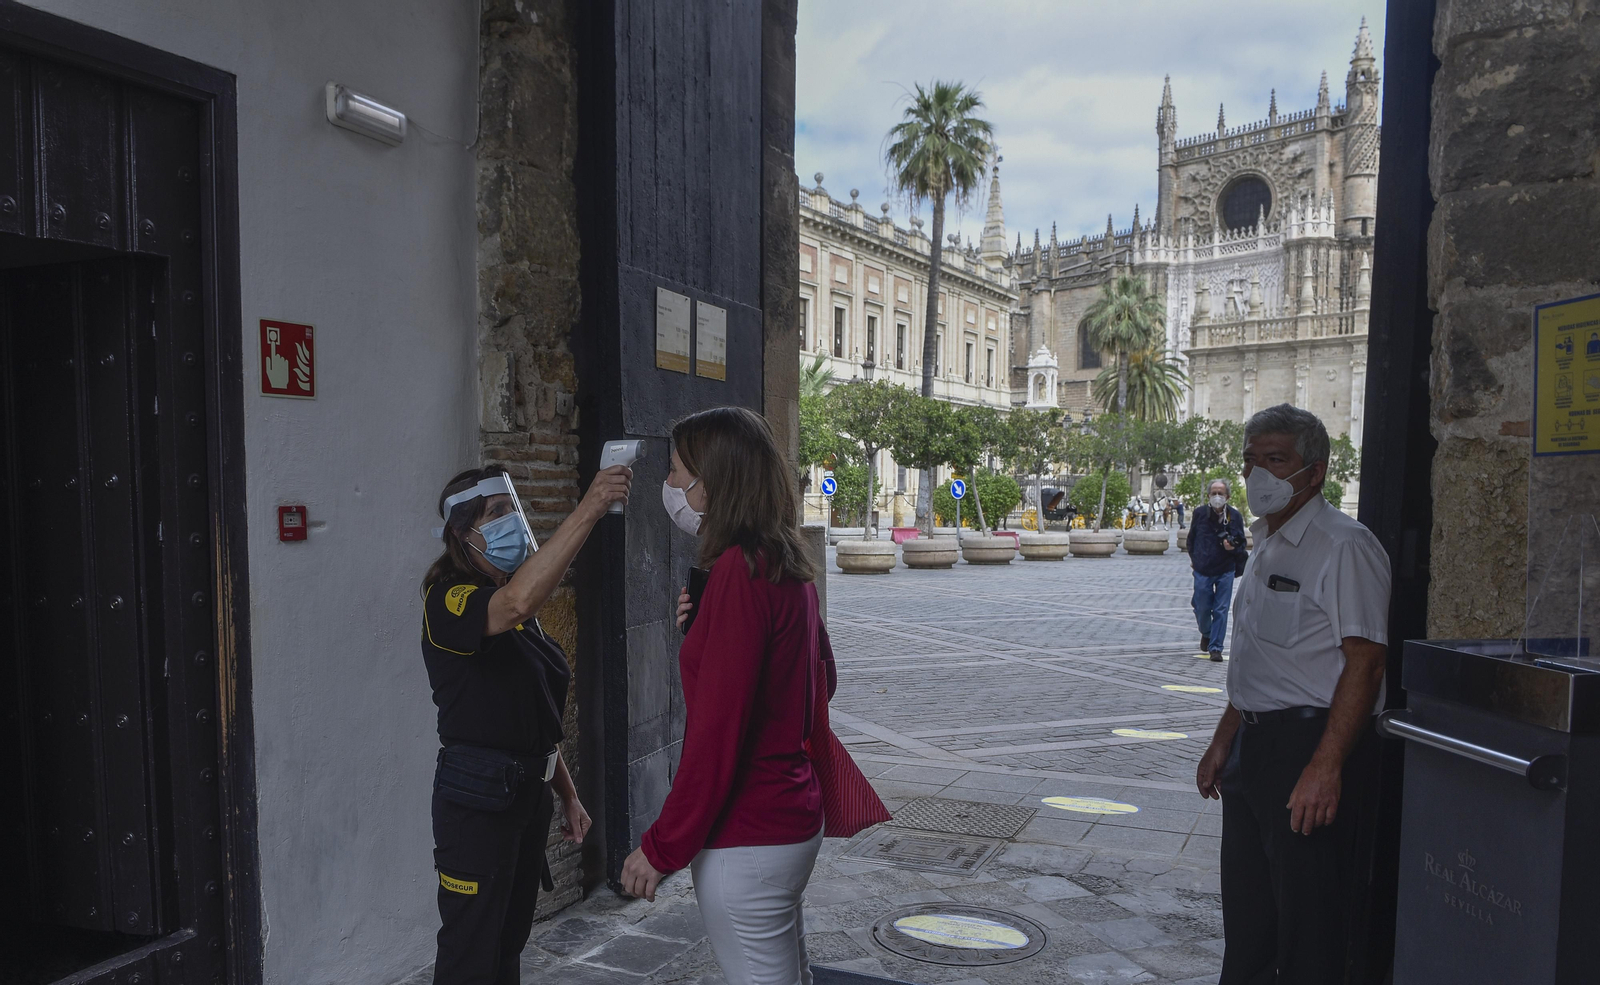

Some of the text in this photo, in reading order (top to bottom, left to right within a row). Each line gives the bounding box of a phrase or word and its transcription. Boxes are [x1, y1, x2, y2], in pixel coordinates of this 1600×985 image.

[1424, 852, 1522, 916] REAL ALCÁZAR
[1444, 892, 1494, 925] SEVILLA
